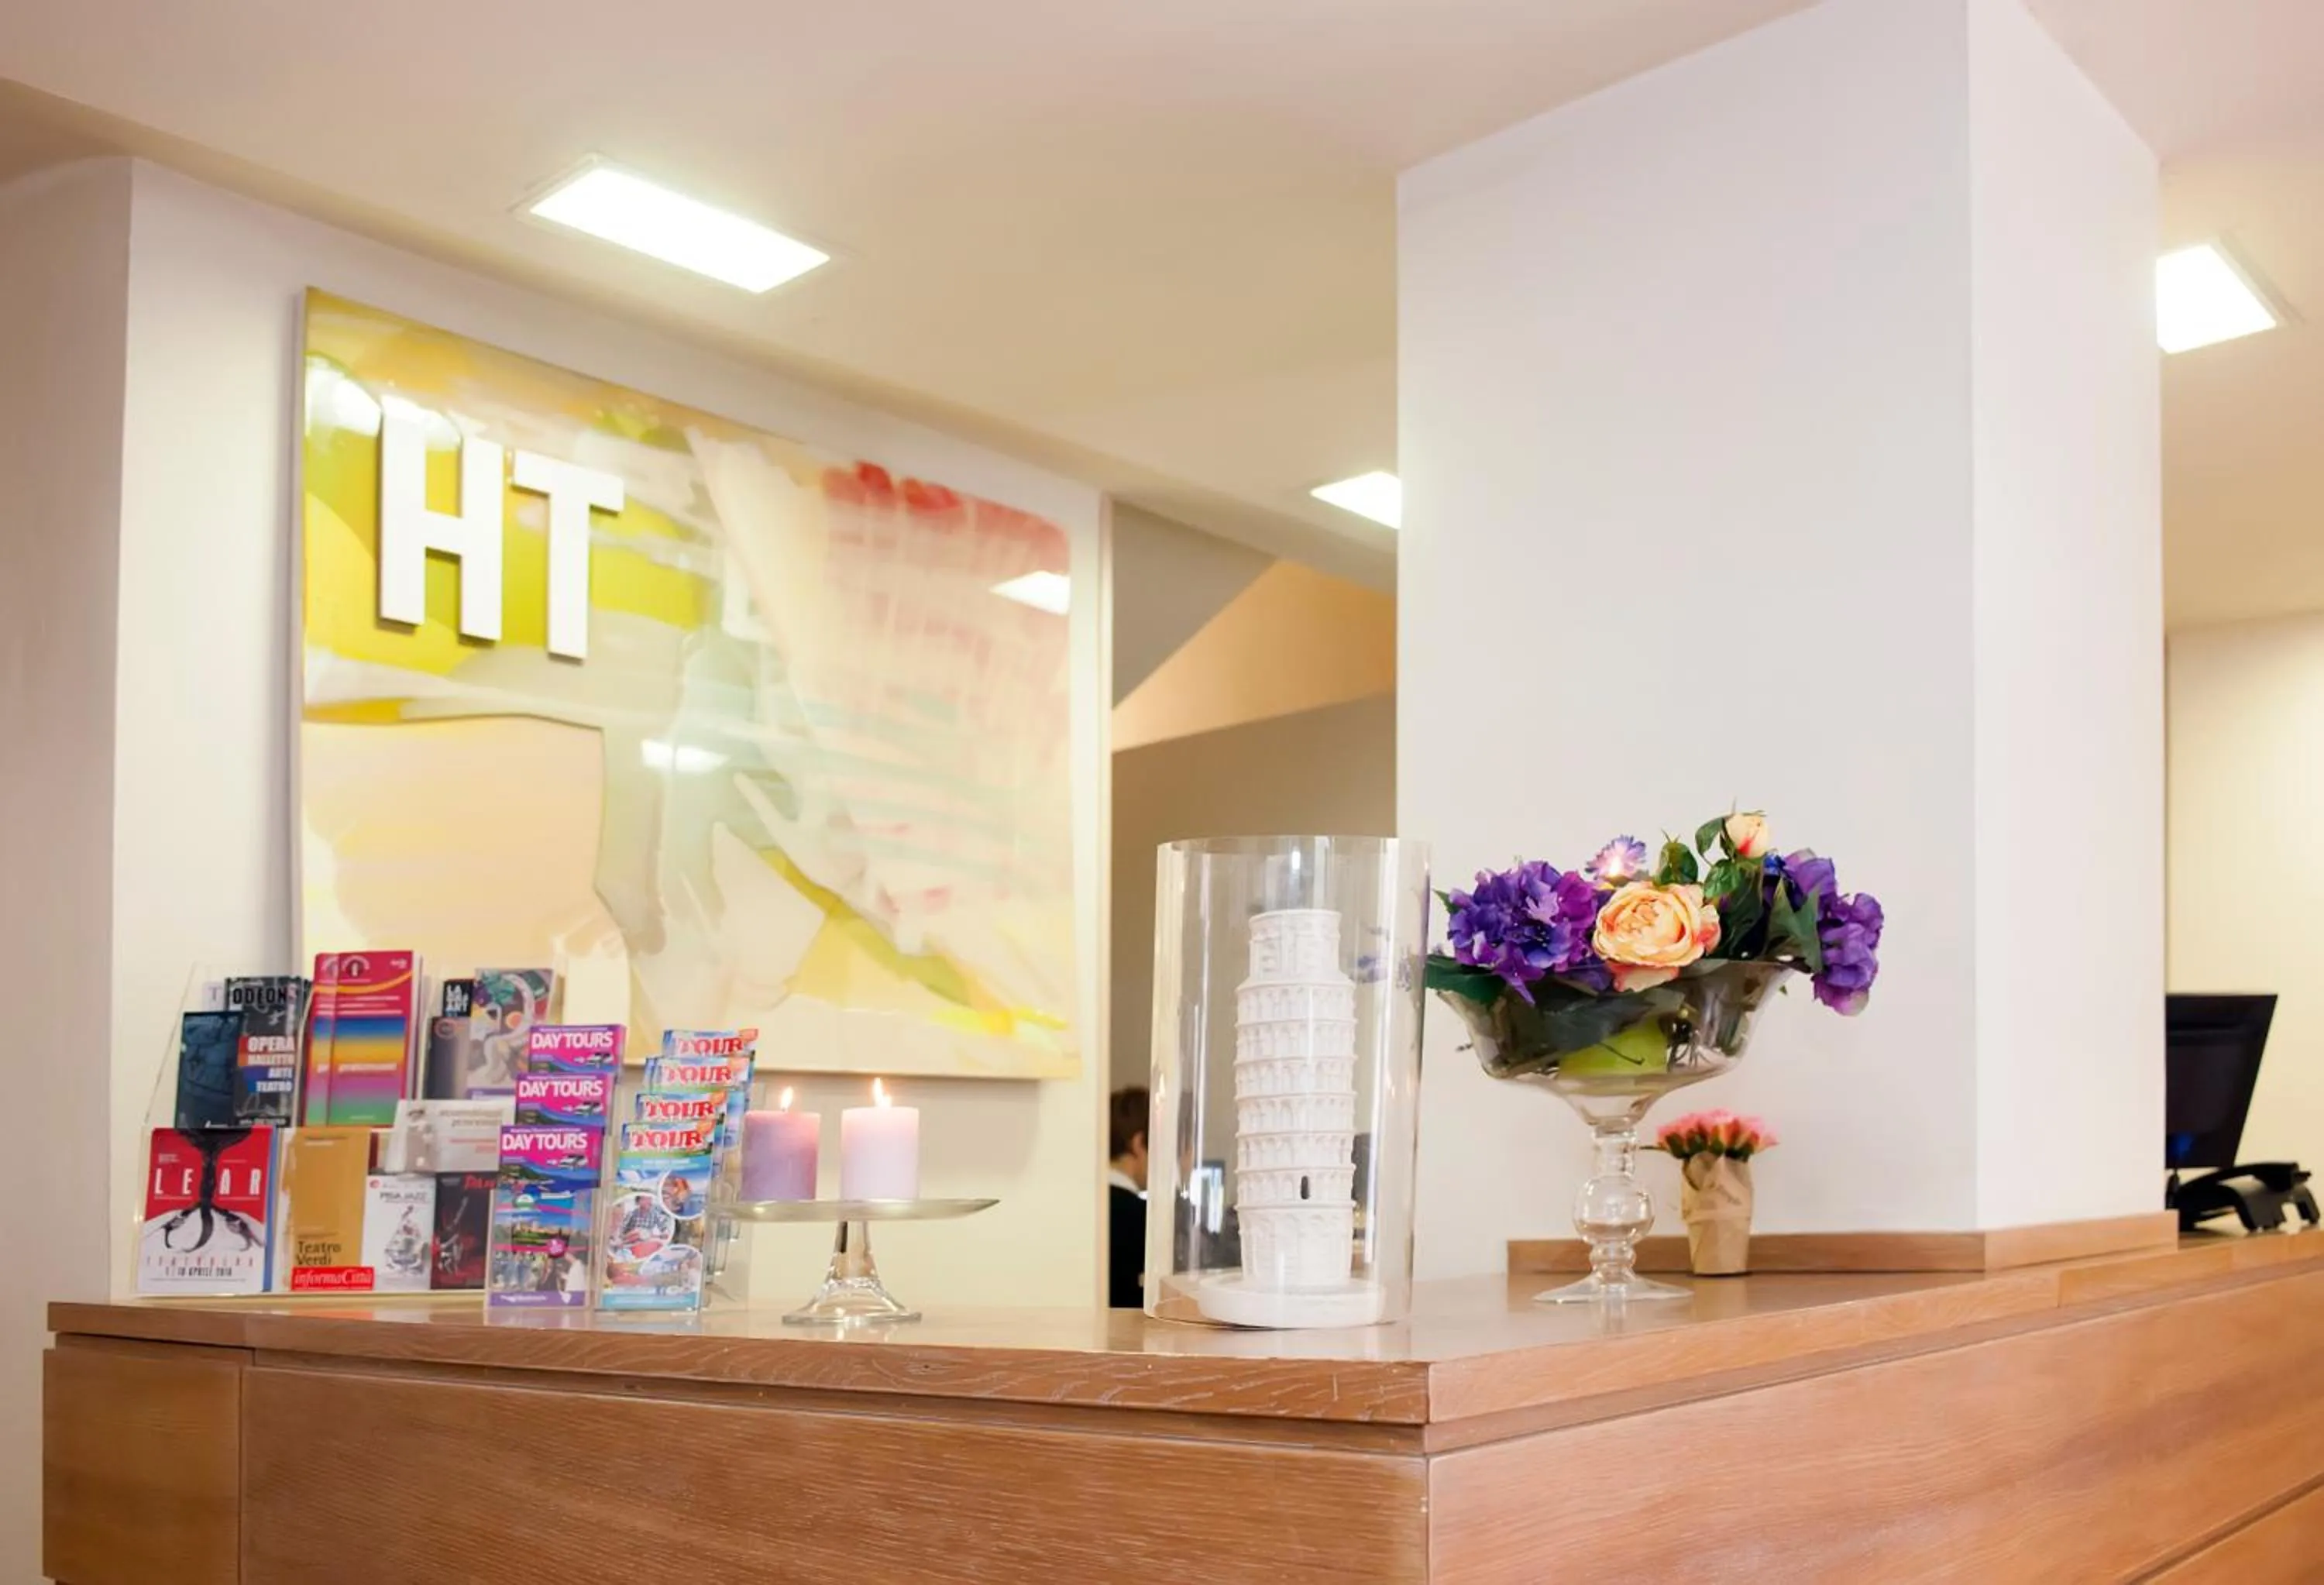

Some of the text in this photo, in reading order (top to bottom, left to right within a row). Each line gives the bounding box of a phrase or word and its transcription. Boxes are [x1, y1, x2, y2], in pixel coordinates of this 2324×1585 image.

[380, 394, 624, 660] HT
[233, 988, 287, 1005] ODEON
[248, 1036, 294, 1053] OPERA
[531, 1031, 614, 1049] DAY TOURS
[675, 1037, 744, 1054] TOUR
[662, 1065, 732, 1082] TOUR
[256, 1081, 293, 1092] TEATRO
[518, 1080, 603, 1097] DAY TOURS
[645, 1100, 715, 1117] TOUR
[501, 1133, 535, 1150] DAY
[538, 1133, 589, 1150] TOURS
[631, 1129, 703, 1148] TOUR
[155, 1168, 263, 1195] LEAR
[297, 1241, 342, 1253] Teatro
[296, 1253, 332, 1266] Verdi
